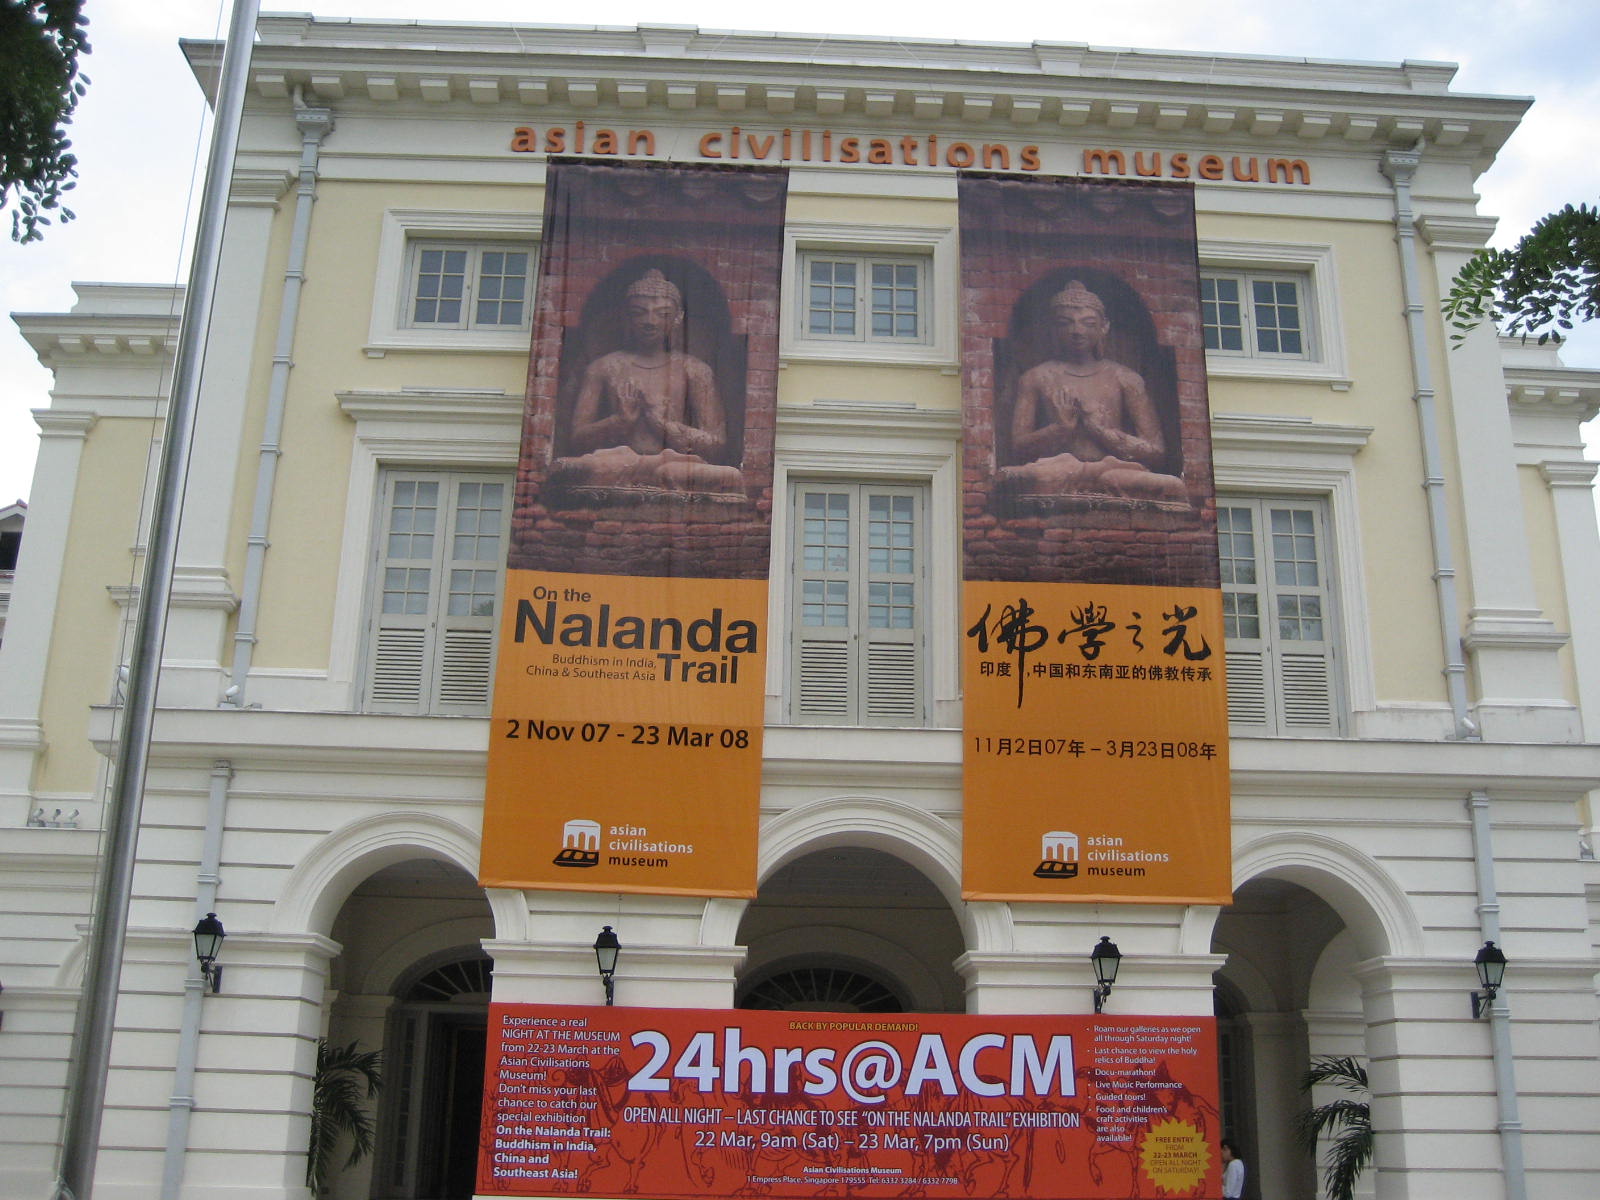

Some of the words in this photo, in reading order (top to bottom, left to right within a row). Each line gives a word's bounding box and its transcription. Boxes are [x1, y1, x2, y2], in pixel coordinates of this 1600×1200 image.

[511, 121, 656, 156] asian
[700, 126, 1042, 172] civilisations
[1083, 147, 1312, 184] museum
[533, 586, 557, 601] On
[564, 588, 592, 603] the
[514, 598, 758, 654] Nalanda
[552, 653, 612, 667] Buddhism
[612, 656, 622, 667] in
[626, 657, 656, 669] India,
[526, 665, 559, 677] China
[561, 667, 570, 677] &
[573, 668, 629, 680] Southeast
[632, 670, 656, 681] Asia
[657, 653, 739, 684] Trail
[506, 719, 519, 739] 2
[527, 720, 575, 741] Nov
[581, 723, 611, 743] 07
[632, 725, 660, 745] 23
[667, 726, 714, 748] Mar
[720, 729, 749, 749] 08
[610, 824, 647, 836] asian
[1087, 834, 1123, 846] asian
[609, 839, 694, 854] civilisations
[608, 855, 668, 868] museum
[1087, 850, 1169, 862] civilisations
[1087, 866, 1146, 876] museum
[503, 1015, 558, 1027] Experience
[560, 1019, 566, 1027] a
[569, 1018, 587, 1027] real
[789, 1022, 814, 1030] BACK
[816, 1022, 828, 1030] BY
[830, 1022, 874, 1031] POPULAR
[874, 1023, 919, 1032] DEMAND!
[502, 1029, 535, 1039] NIGHT
[537, 1030, 550, 1040] AT
[552, 1031, 571, 1040] THE
[574, 1031, 621, 1041] MUSEUM
[1130, 1025, 1160, 1034] galleries
[1104, 1035, 1135, 1043] through
[1136, 1035, 1169, 1043] Saturday
[1170, 1035, 1192, 1044] night!
[501, 1043, 525, 1053] from
[528, 1043, 555, 1054] 22-23
[558, 1045, 588, 1055] March
[591, 1046, 600, 1055] at
[603, 1045, 620, 1055] the
[1167, 1047, 1180, 1055] the
[1181, 1047, 1198, 1056] holy
[500, 1056, 528, 1066] Asian
[530, 1057, 590, 1068] Civilisations
[628, 1027, 1076, 1104] 24hrs@ACM
[1125, 1056, 1156, 1064] Buddha!
[499, 1070, 547, 1080] Museum!
[1095, 1068, 1156, 1076] Docu-marathon!
[529, 1085, 551, 1094] miss
[554, 1088, 578, 1097] your
[579, 1086, 597, 1096] last
[1095, 1081, 1111, 1089] Live
[1112, 1081, 1134, 1089] Music
[1135, 1081, 1183, 1089] Performance
[498, 1098, 535, 1108] chance
[537, 1100, 547, 1108] to
[550, 1099, 578, 1109] catch
[580, 1102, 597, 1110] our
[497, 1112, 531, 1123] special
[534, 1113, 586, 1123] exhibition
[624, 1107, 656, 1124] OPEN
[659, 1107, 682, 1124] ALL
[685, 1108, 722, 1124] NIGHT
[737, 1110, 766, 1126] LAST
[769, 1110, 818, 1126] CHANCE
[819, 1111, 834, 1126] TO
[837, 1111, 858, 1126] SEE
[888, 1112, 910, 1128] THE
[914, 1112, 970, 1128] NALANDA
[1013, 1112, 1080, 1128] EXHIBITION
[497, 1125, 512, 1135] On
[515, 1126, 532, 1136] the
[535, 1126, 581, 1137] Nalanda
[583, 1128, 611, 1138] Trail:
[695, 1132, 716, 1146] 22
[721, 1132, 756, 1150] Mar,
[761, 1132, 796, 1148] 9am
[802, 1132, 840, 1150] (Sat)
[859, 1134, 878, 1148] 23
[884, 1135, 918, 1152] Mar,
[924, 1135, 960, 1152] 7pm
[967, 1134, 1008, 1152] (Sun)
[1096, 1134, 1132, 1142] available!
[495, 1139, 550, 1150] Buddhism
[553, 1141, 563, 1150] in
[566, 1141, 597, 1152] India,
[494, 1153, 526, 1163] China
[528, 1154, 549, 1164] and
[493, 1167, 549, 1178] Southeast
[551, 1169, 578, 1179] Asia!
[803, 1166, 824, 1174] Asian
[825, 1166, 870, 1174] Civilisations
[752, 1176, 782, 1184] Empress
[804, 1176, 840, 1184] Singapore
